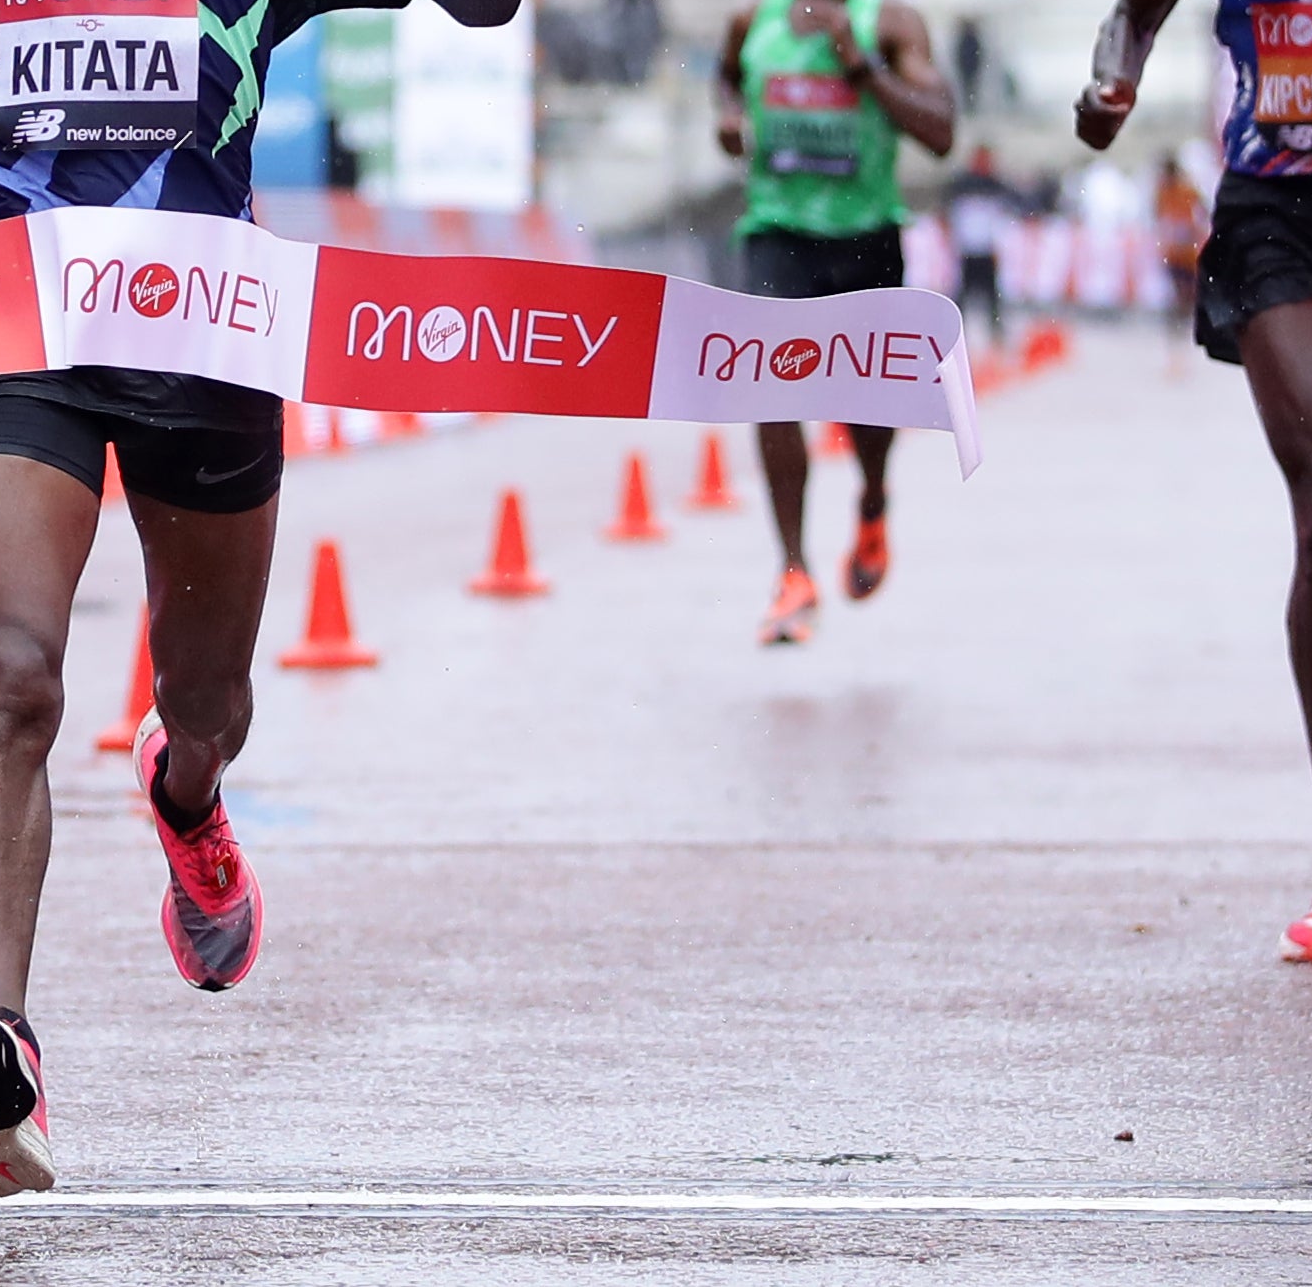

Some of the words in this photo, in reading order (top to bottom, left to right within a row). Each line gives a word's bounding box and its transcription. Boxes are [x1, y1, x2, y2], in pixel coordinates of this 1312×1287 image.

[11, 40, 180, 96] KITATA
[66, 128, 100, 142] new
[105, 125, 178, 142] balance
[63, 257, 279, 338] MONEY
[132, 269, 177, 311] Virgin
[345, 301, 618, 369] MONEY
[421, 315, 462, 355] Virgin
[772, 345, 819, 377] Virgin
